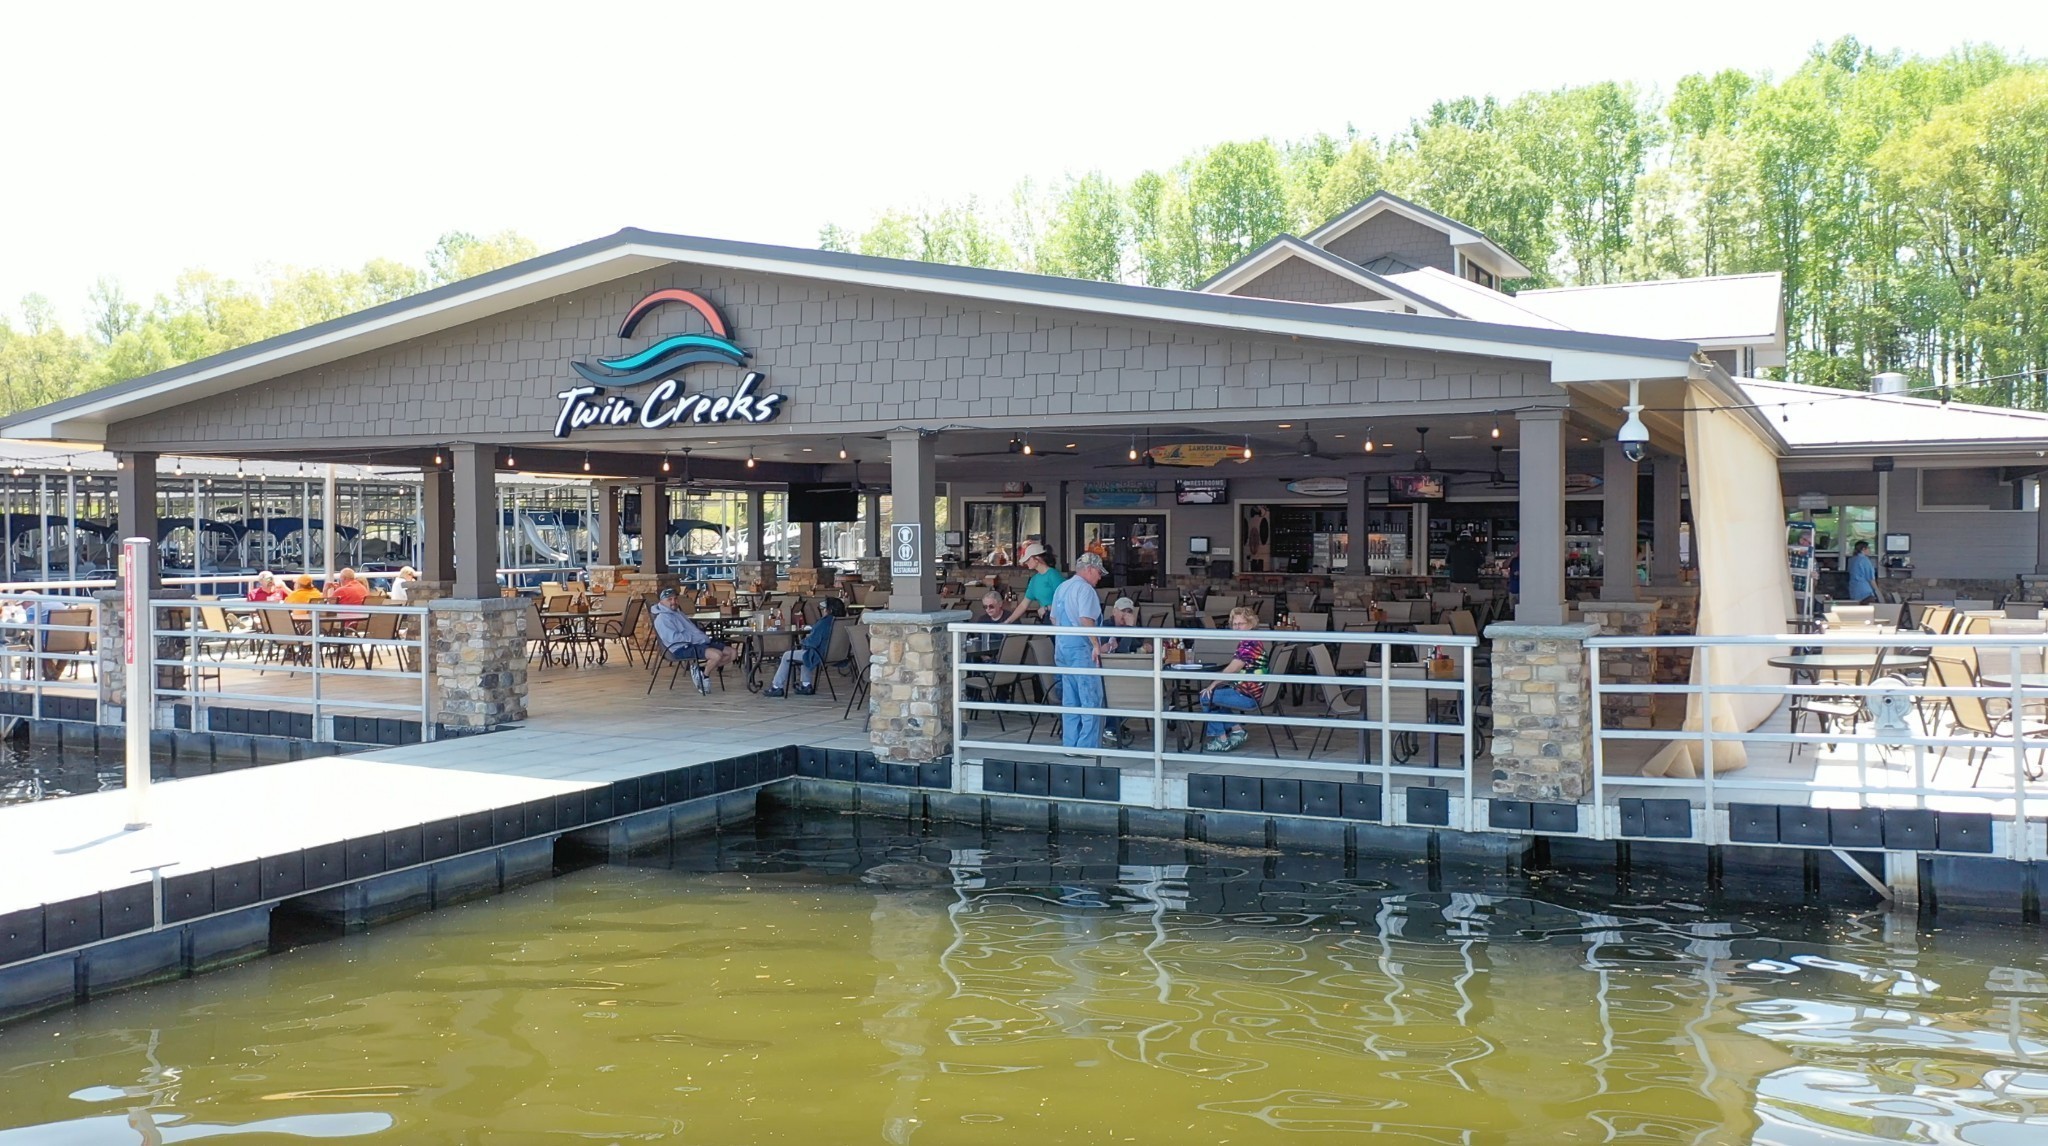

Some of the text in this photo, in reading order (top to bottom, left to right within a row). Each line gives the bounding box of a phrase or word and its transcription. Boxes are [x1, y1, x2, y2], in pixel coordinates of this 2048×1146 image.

[554, 371, 784, 438] Twin Creeks
[1190, 479, 1224, 487] RESTROOMS
